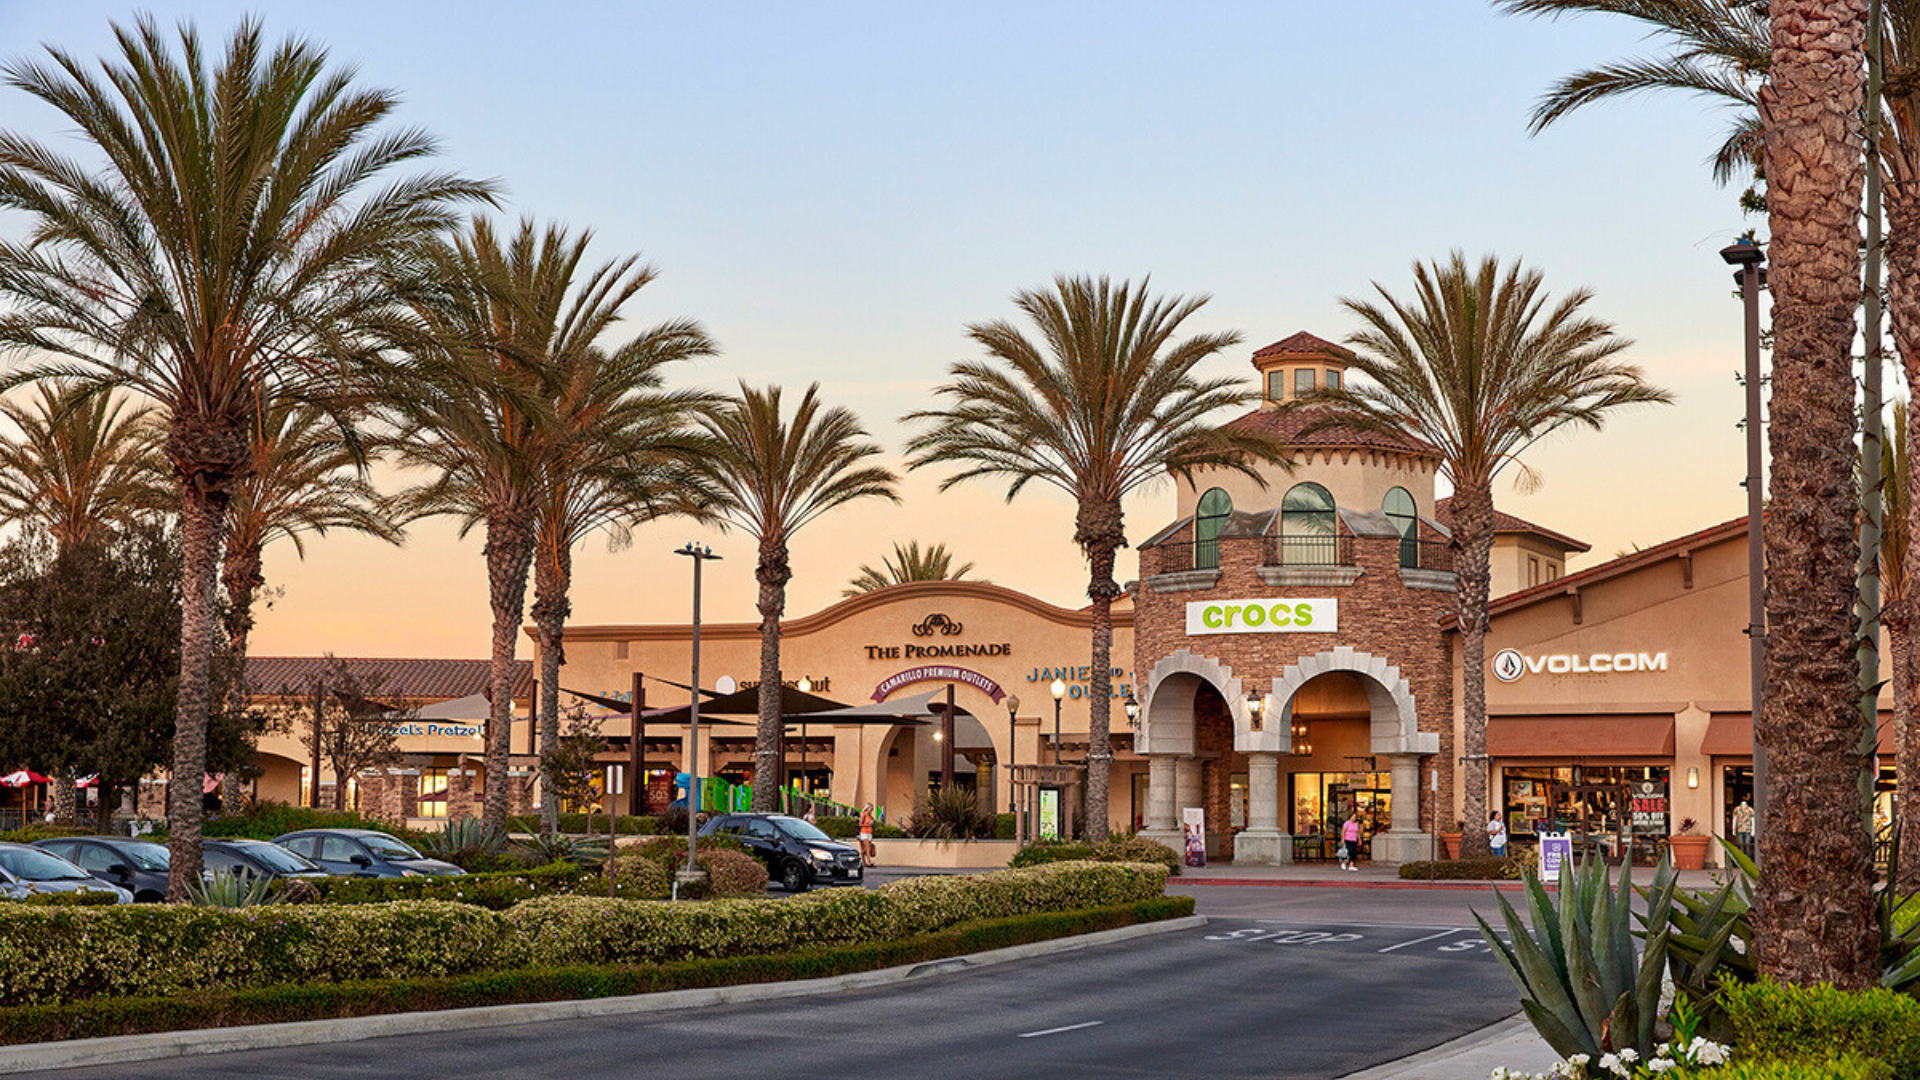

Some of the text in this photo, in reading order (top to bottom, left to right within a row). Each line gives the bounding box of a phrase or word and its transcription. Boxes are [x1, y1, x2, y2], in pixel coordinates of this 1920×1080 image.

[1202, 603, 1313, 628] crocs
[1524, 652, 1667, 673] VOLCOM
[880, 667, 993, 692] CAMARILLO PREMIUM OUTLETS
[1026, 665, 1091, 682] JANIE
[1632, 798, 1664, 812] SALE
[1204, 929, 1364, 945] STOP
